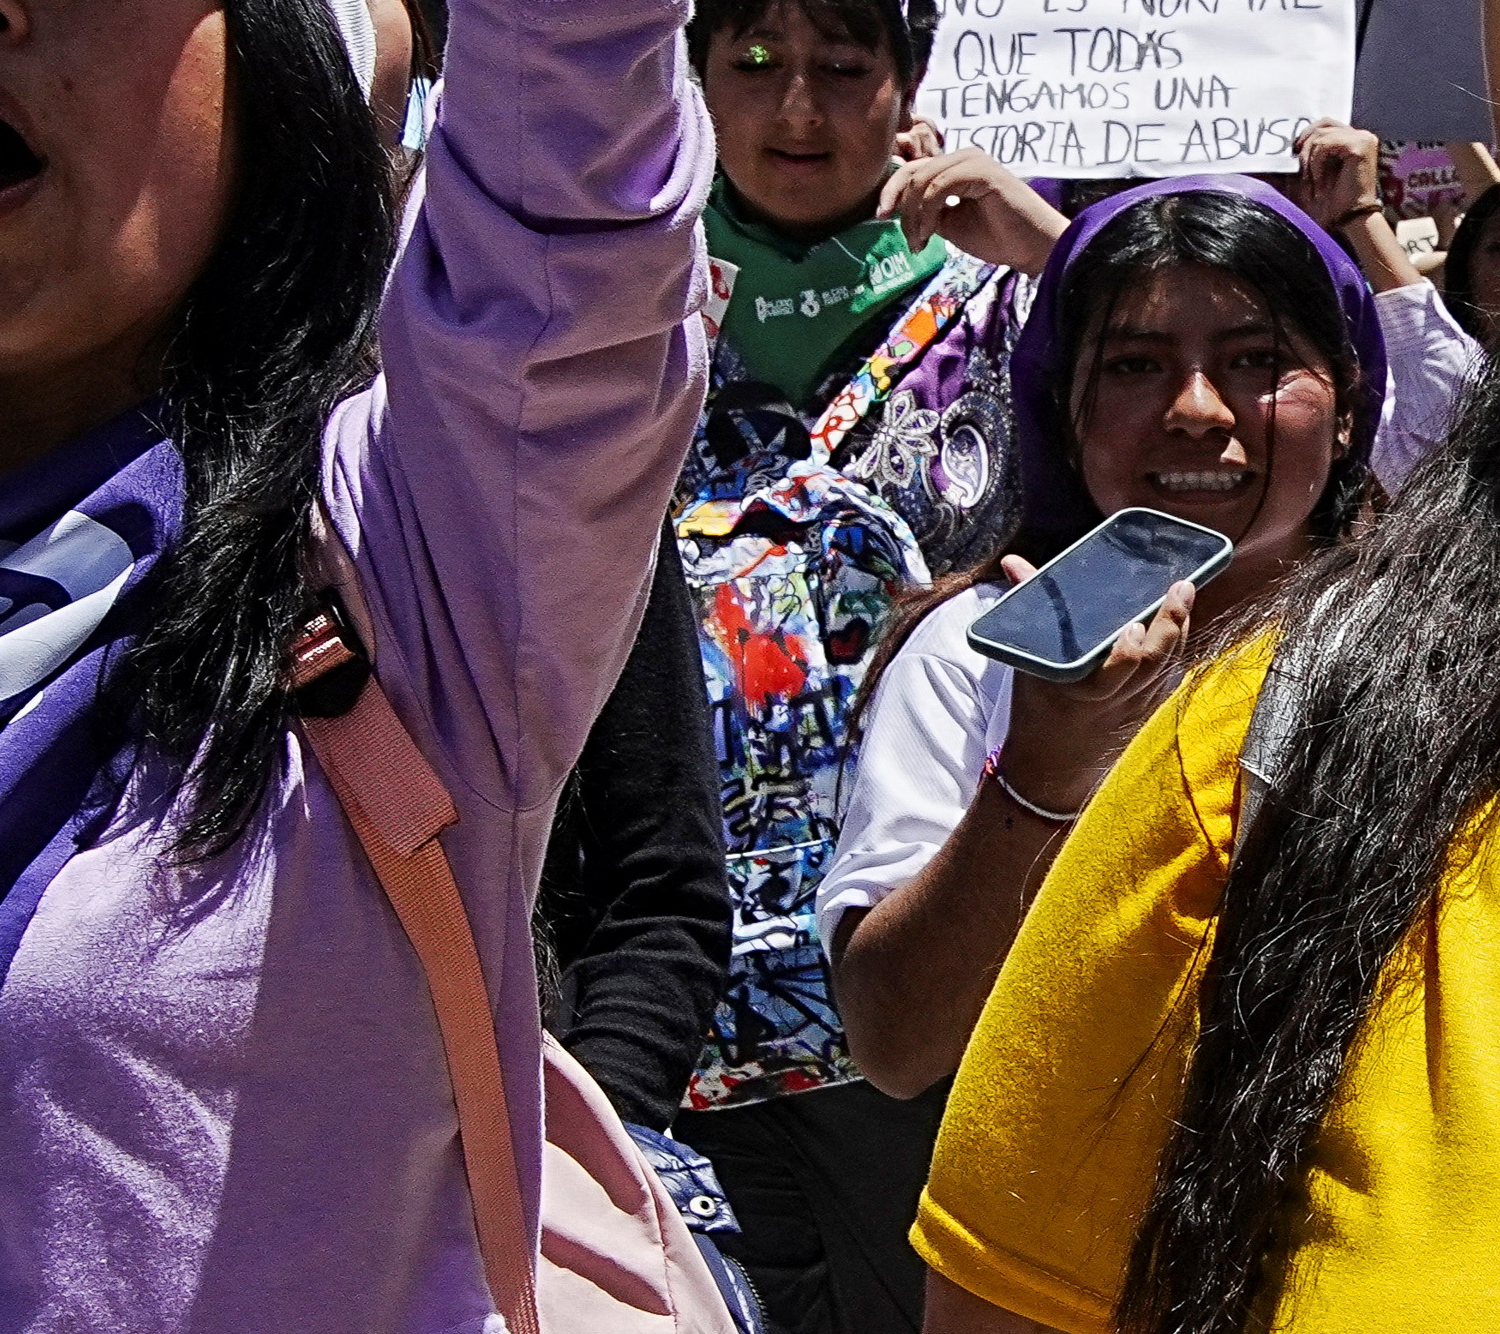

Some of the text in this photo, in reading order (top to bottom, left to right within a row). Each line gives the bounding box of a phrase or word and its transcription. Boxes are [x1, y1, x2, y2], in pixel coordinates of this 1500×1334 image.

[953, 27, 1184, 82] QUE TODAS
[927, 75, 1239, 119] TENGAMOS UNA
[943, 120, 1085, 166] ISTORIA
[1095, 121, 1166, 166] DE
